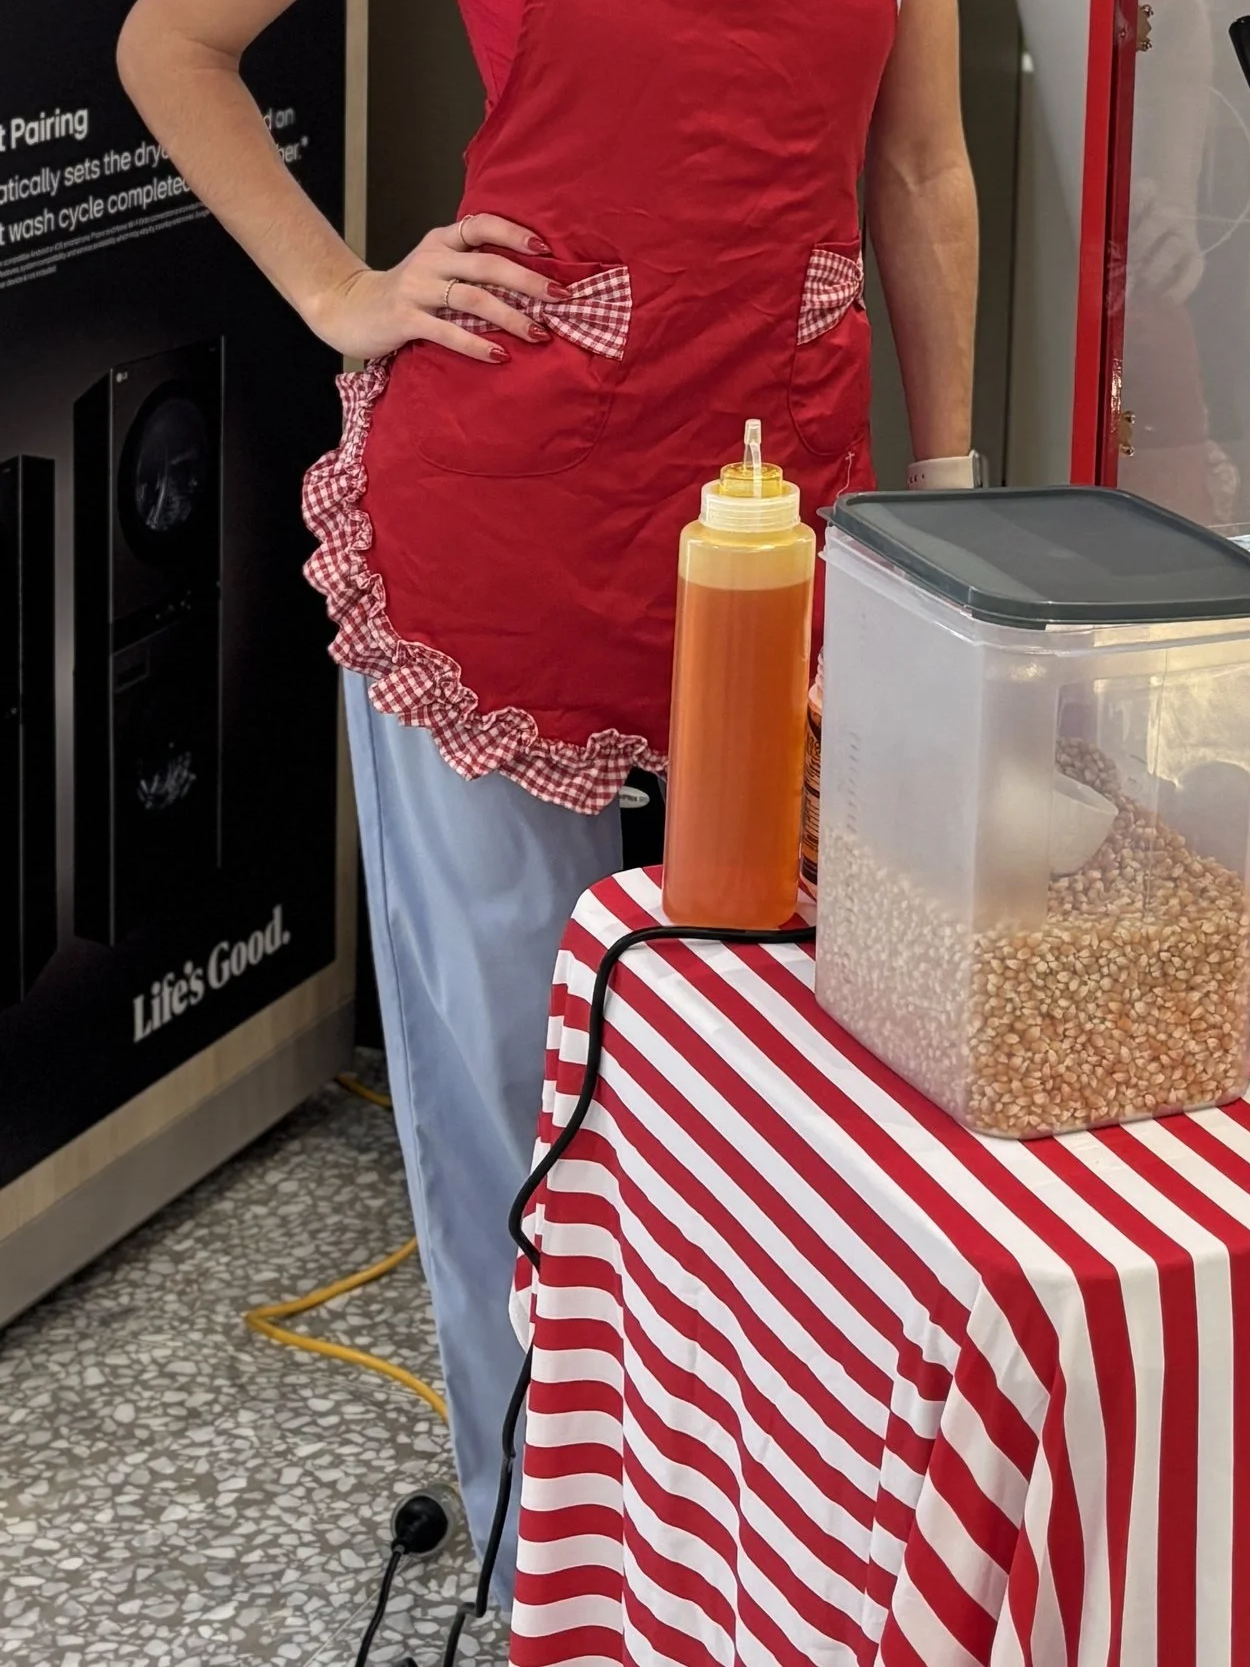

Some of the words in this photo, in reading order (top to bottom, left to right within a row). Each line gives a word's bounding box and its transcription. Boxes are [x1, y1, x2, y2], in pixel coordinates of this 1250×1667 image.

[10, 108, 89, 149] Pairing
[64, 157, 100, 187] sets
[104, 149, 131, 175] the
[275, 108, 295, 129] on
[8, 207, 55, 243] wash
[58, 196, 104, 231] cycle
[133, 959, 204, 1044] Life's
[207, 903, 291, 990] Good.
